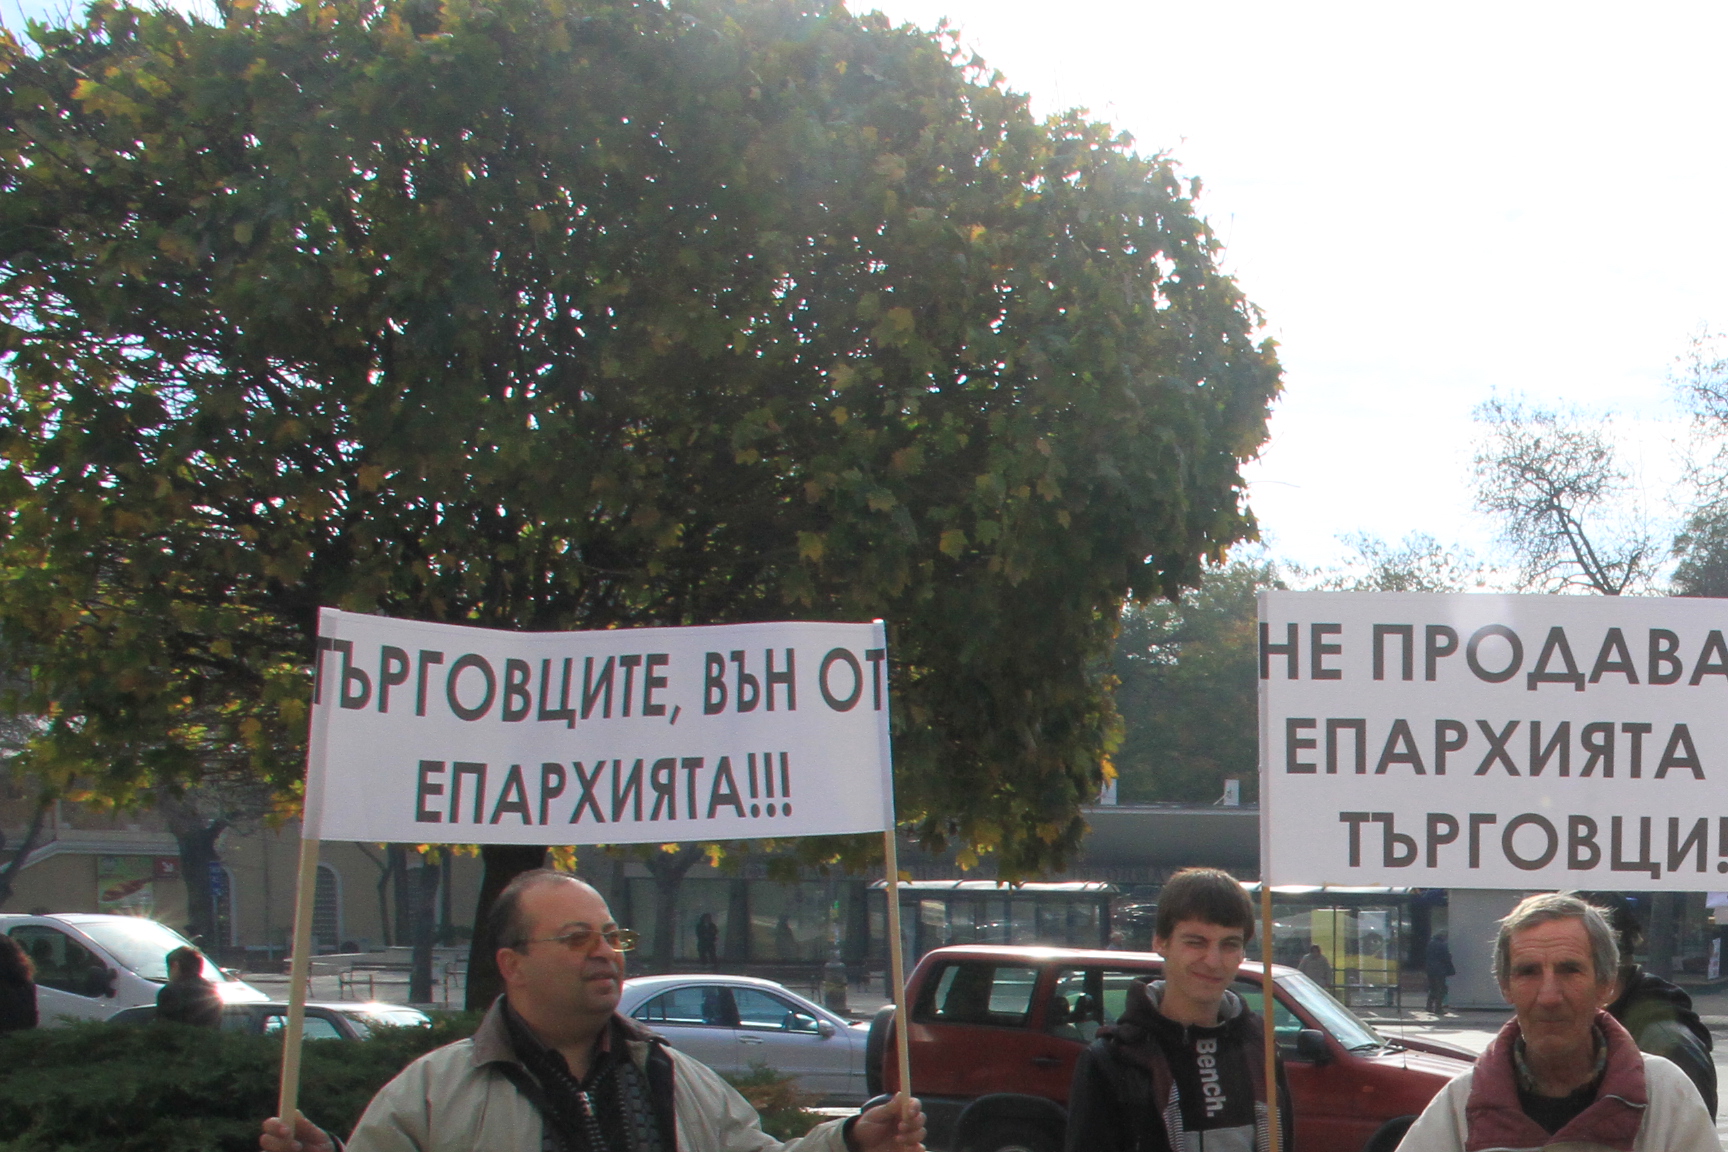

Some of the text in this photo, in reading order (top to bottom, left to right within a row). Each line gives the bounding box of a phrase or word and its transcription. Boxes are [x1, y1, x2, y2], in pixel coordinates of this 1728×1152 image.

[703, 648, 796, 716] ВЪН
[818, 647, 886, 712] ОТ
[1259, 622, 1343, 681] НЕ
[1285, 718, 1706, 780] ЕПАРХИЯТА
[415, 752, 793, 826] ЕПАРХИЯТА!!!
[1196, 1038, 1226, 1117] Bench.
